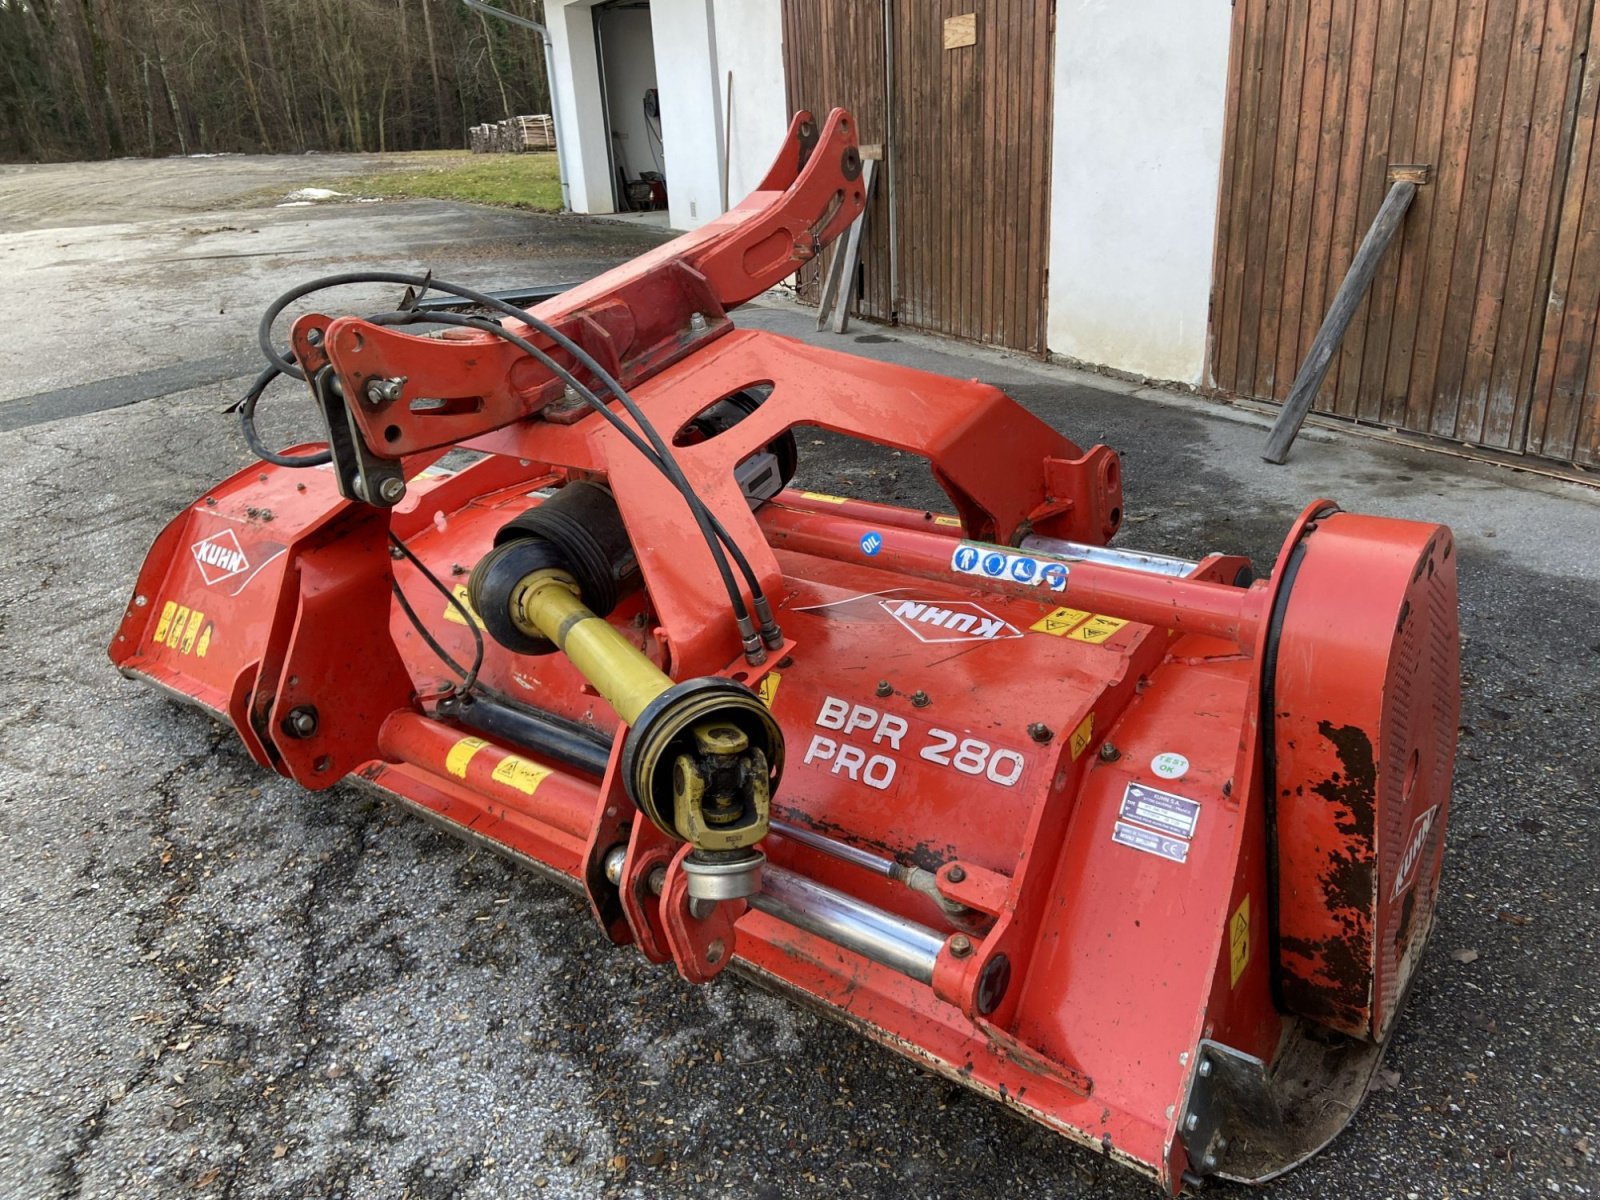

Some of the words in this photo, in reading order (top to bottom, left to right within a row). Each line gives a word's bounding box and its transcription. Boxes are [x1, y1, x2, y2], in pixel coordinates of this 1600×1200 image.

[198, 540, 243, 574] KUHN
[862, 536, 880, 554] OIL
[894, 600, 1006, 638] KUHN
[815, 695, 909, 751] BPR
[919, 728, 1025, 787] 280
[803, 734, 897, 790] PRO
[1159, 764, 1174, 773] OK
[1160, 755, 1187, 767] TEST
[1395, 810, 1431, 896] KUHN
